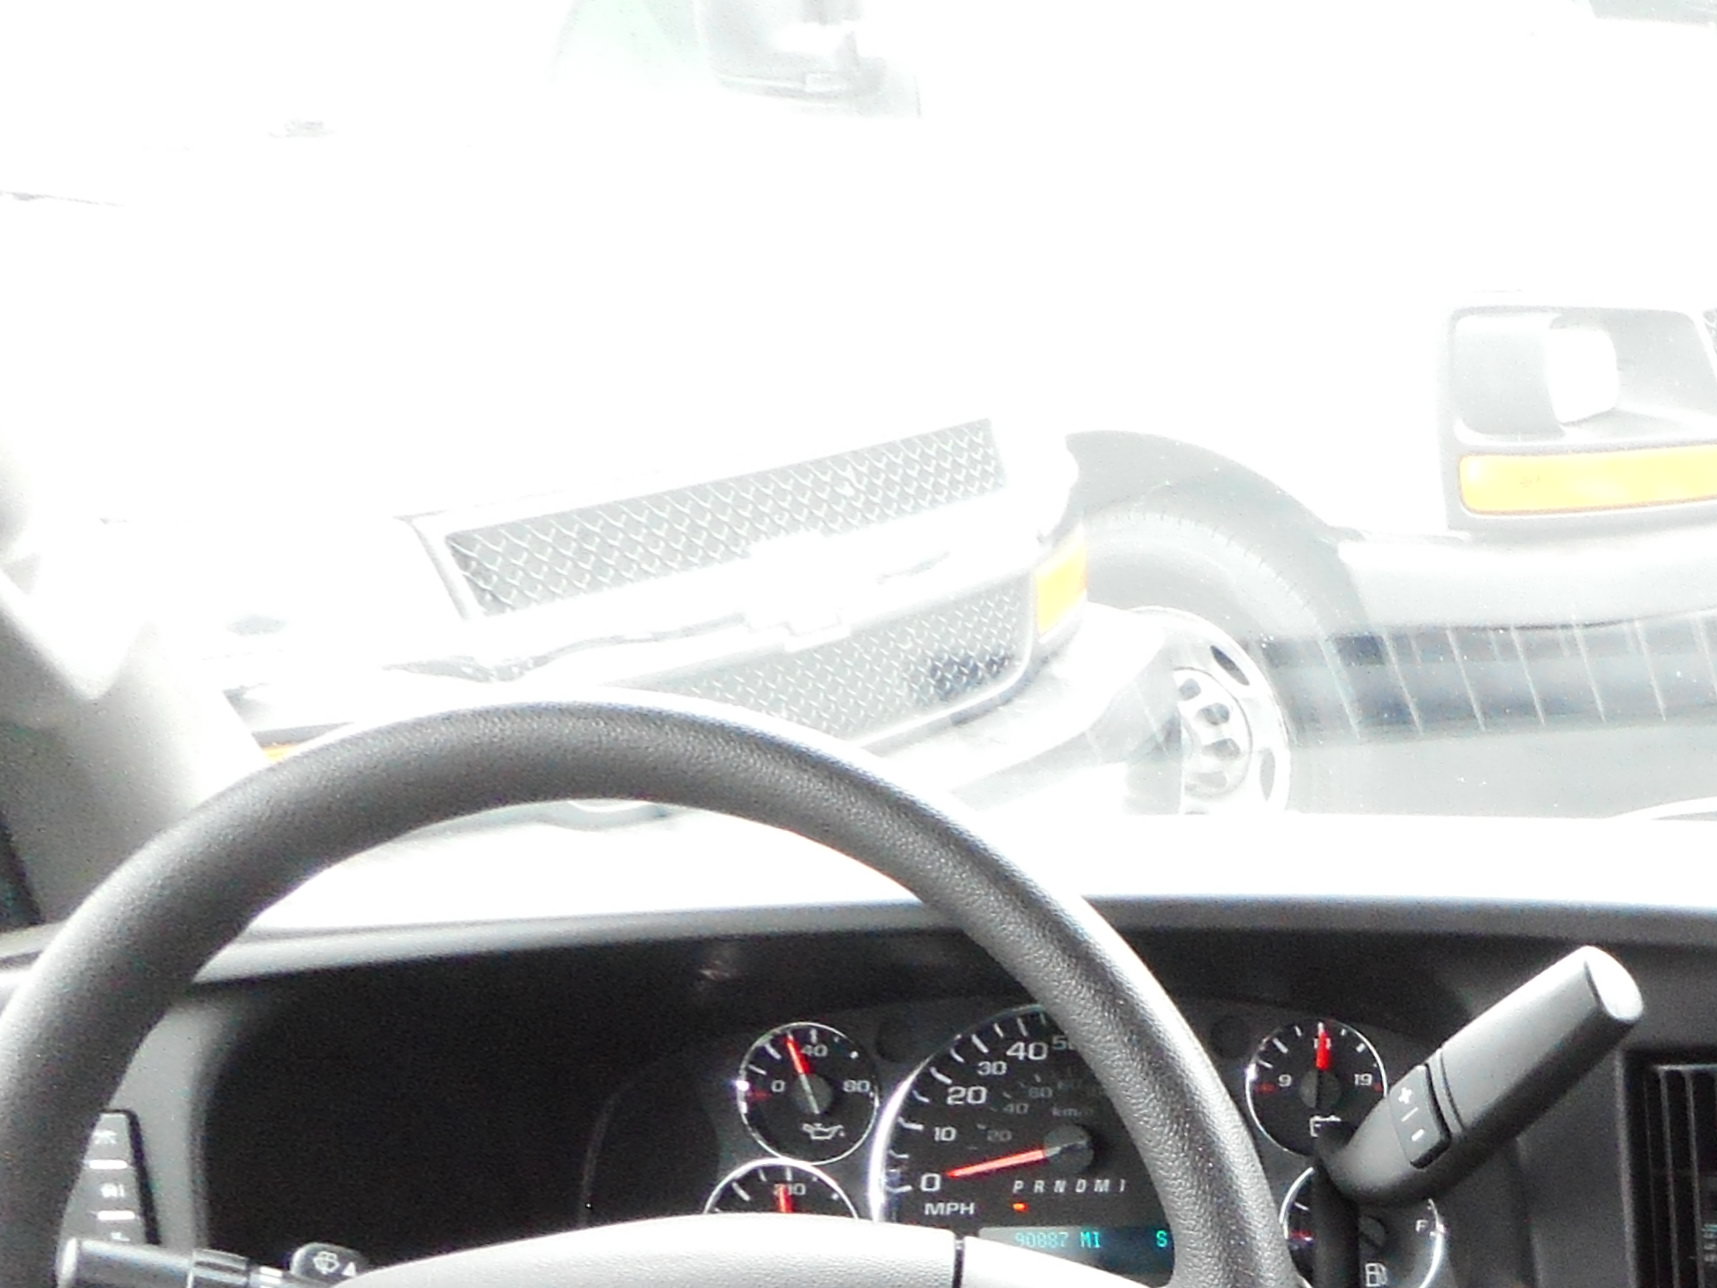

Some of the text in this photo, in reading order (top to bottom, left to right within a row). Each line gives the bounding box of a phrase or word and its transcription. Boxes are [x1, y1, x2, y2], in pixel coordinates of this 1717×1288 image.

[801, 1044, 828, 1058] 40
[1006, 1041, 1048, 1061] 40
[977, 1060, 1007, 1076] 30
[771, 1079, 786, 1093] 0
[842, 1079, 871, 1094] 80
[1278, 1074, 1293, 1088] 9
[1354, 1073, 1373, 1087] 19
[946, 1085, 988, 1105] 20
[1003, 1102, 1029, 1115] 40
[933, 1126, 957, 1142] 10
[920, 1172, 941, 1192] 0
[924, 1202, 976, 1216] MPH
[1415, 1219, 1429, 1233] F
[1080, 1231, 1101, 1248] MI
